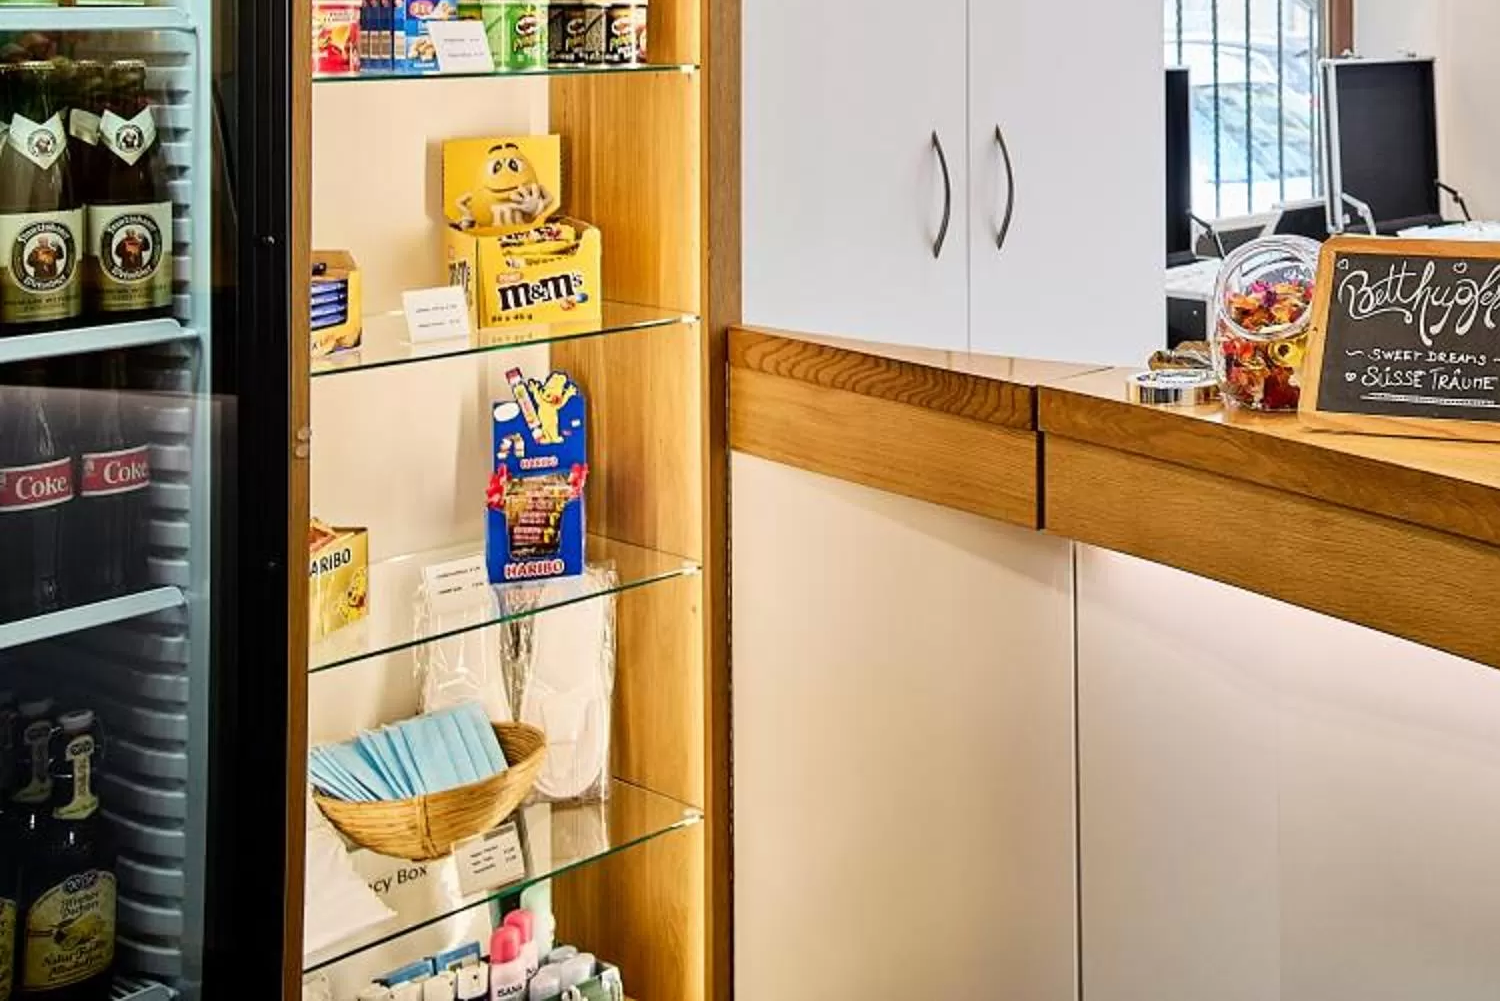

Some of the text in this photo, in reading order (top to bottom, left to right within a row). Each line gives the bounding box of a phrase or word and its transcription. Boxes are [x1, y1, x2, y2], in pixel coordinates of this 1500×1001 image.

[15, 475, 67, 500] Coke
[310, 547, 351, 576] ARIBO
[504, 559, 565, 580] HARIBO
[397, 864, 428, 884] Box
